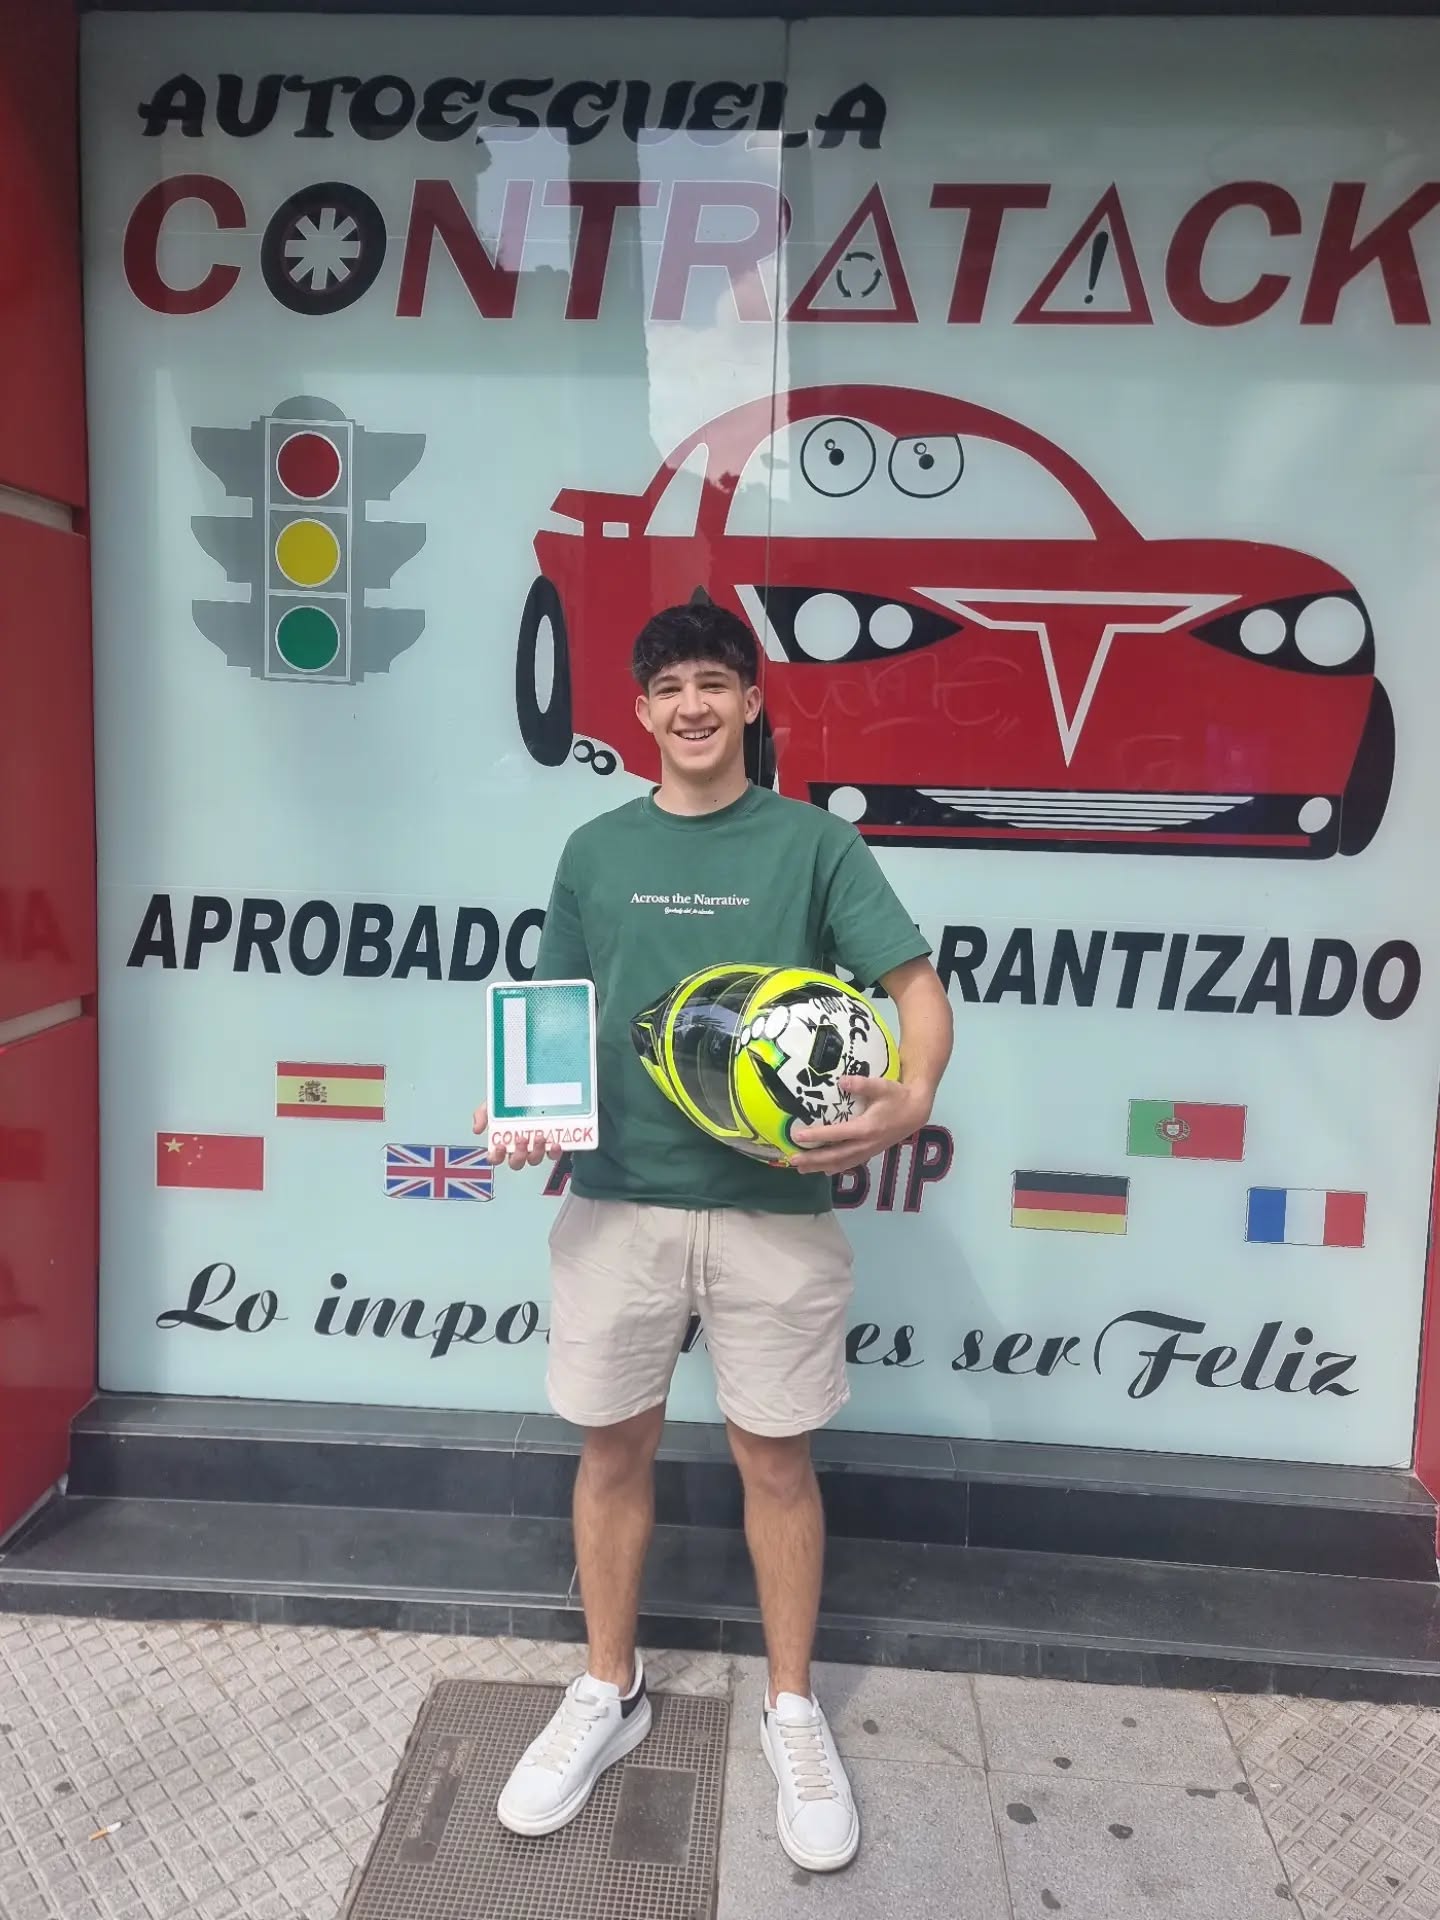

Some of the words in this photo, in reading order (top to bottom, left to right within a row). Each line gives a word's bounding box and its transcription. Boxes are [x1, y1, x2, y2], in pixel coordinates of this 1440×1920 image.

[138, 73, 887, 151] AUTOESCUELA
[123, 173, 1440, 327] CONTRATACK
[126, 893, 547, 982] APROBADO
[835, 923, 1422, 1020] RANTIZADO
[630, 892, 670, 904] Across
[672, 893, 691, 904] the
[693, 894, 750, 906] Narrative
[503, 997, 582, 1107] L
[155, 1262, 289, 1332] Lo
[845, 1322, 924, 1367] es
[952, 1329, 1081, 1376] ser
[1094, 1310, 1359, 1399] Feliz
